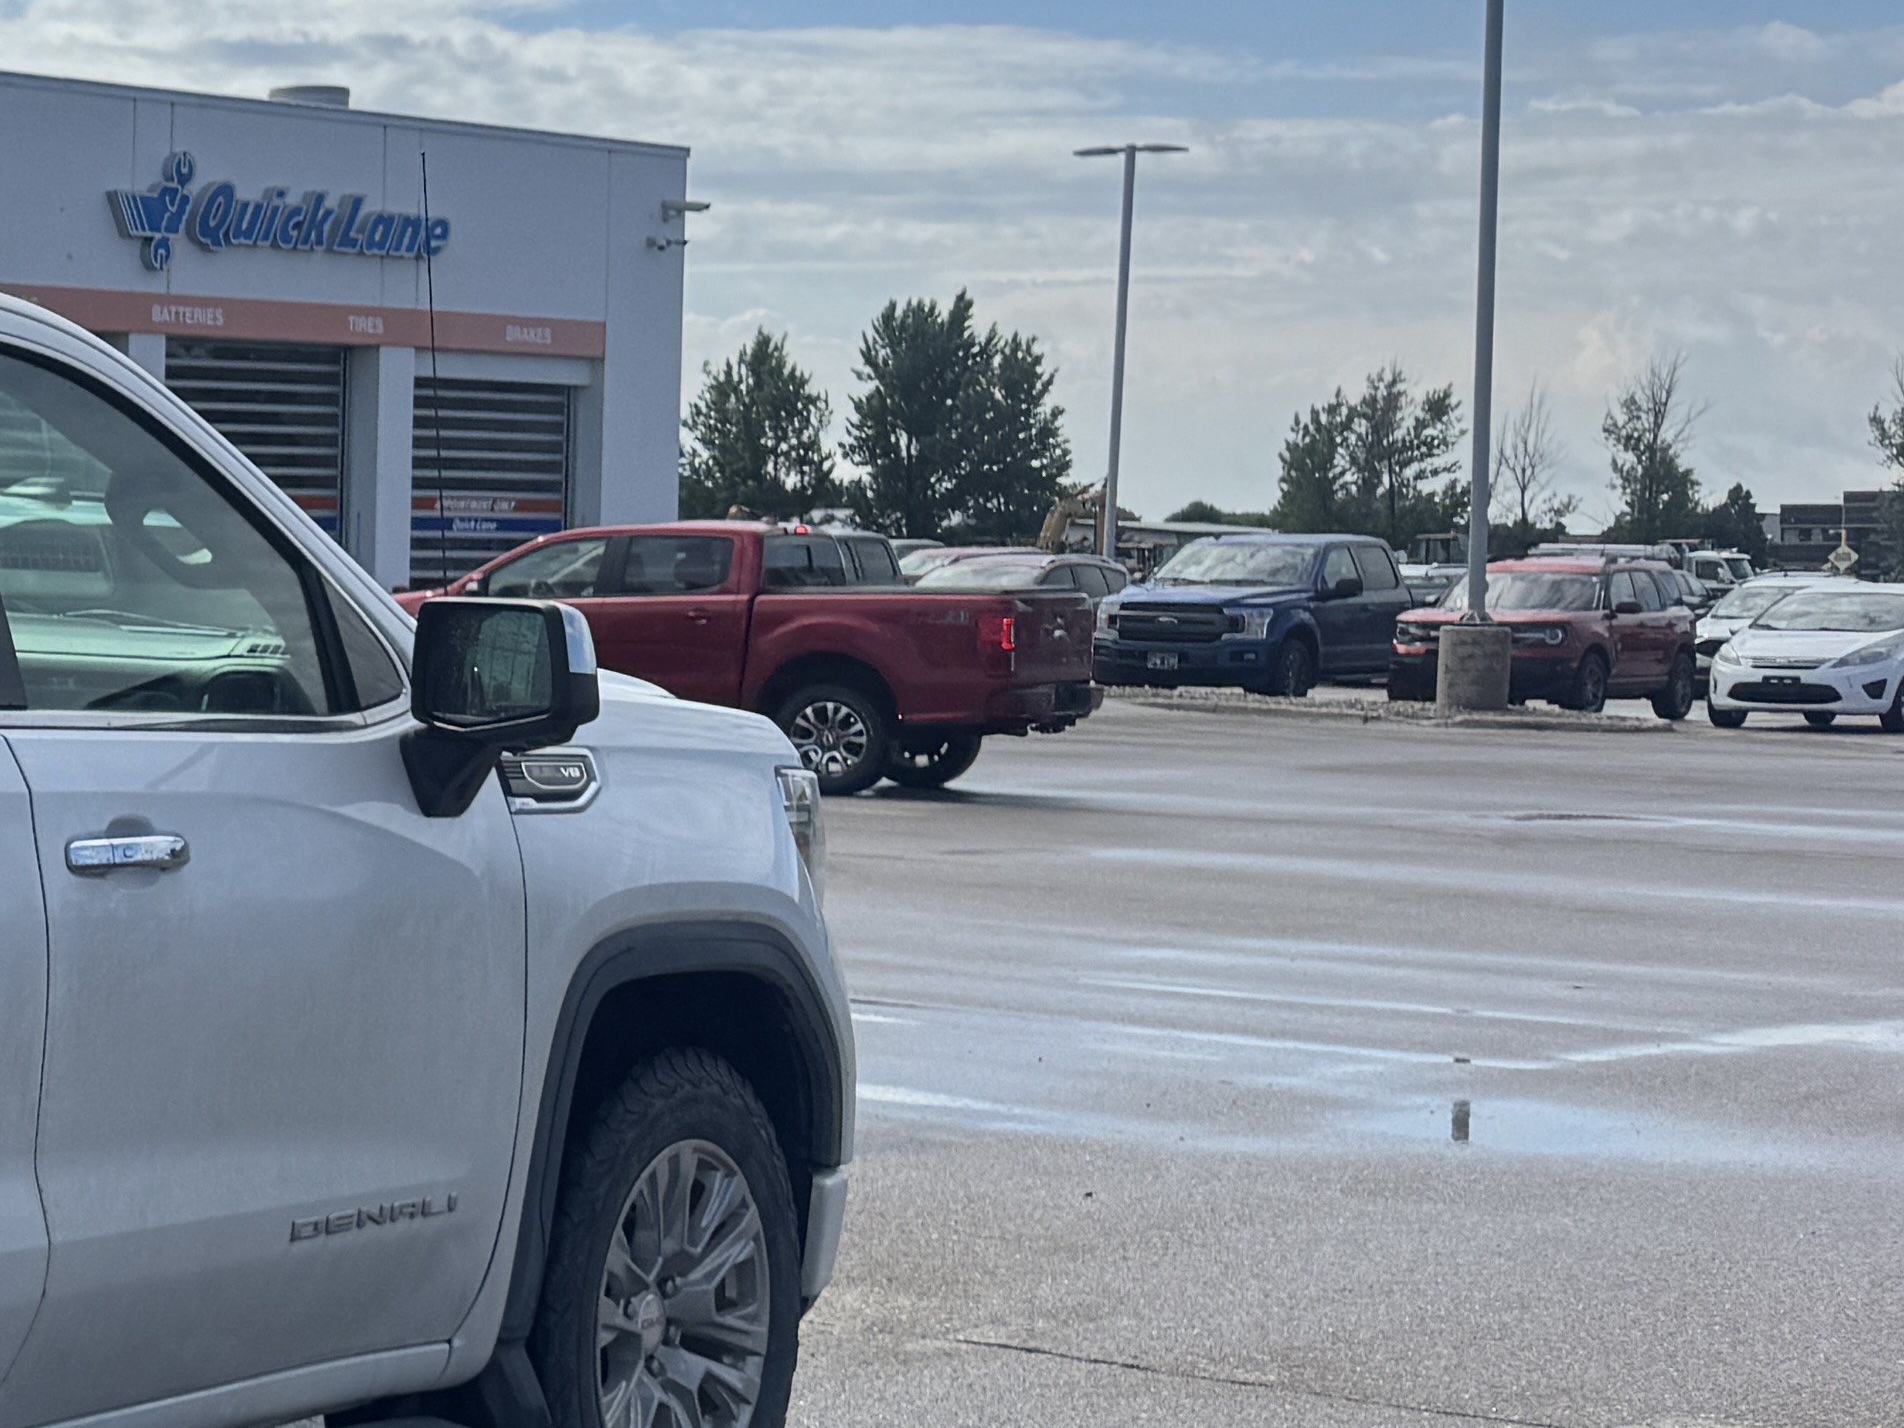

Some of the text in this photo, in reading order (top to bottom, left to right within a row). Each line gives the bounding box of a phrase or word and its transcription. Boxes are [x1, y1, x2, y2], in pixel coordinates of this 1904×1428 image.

[151, 304, 552, 345] BATTERIES TIRES BRAKES
[560, 766, 581, 778] V8
[289, 1191, 458, 1243] DENALI
